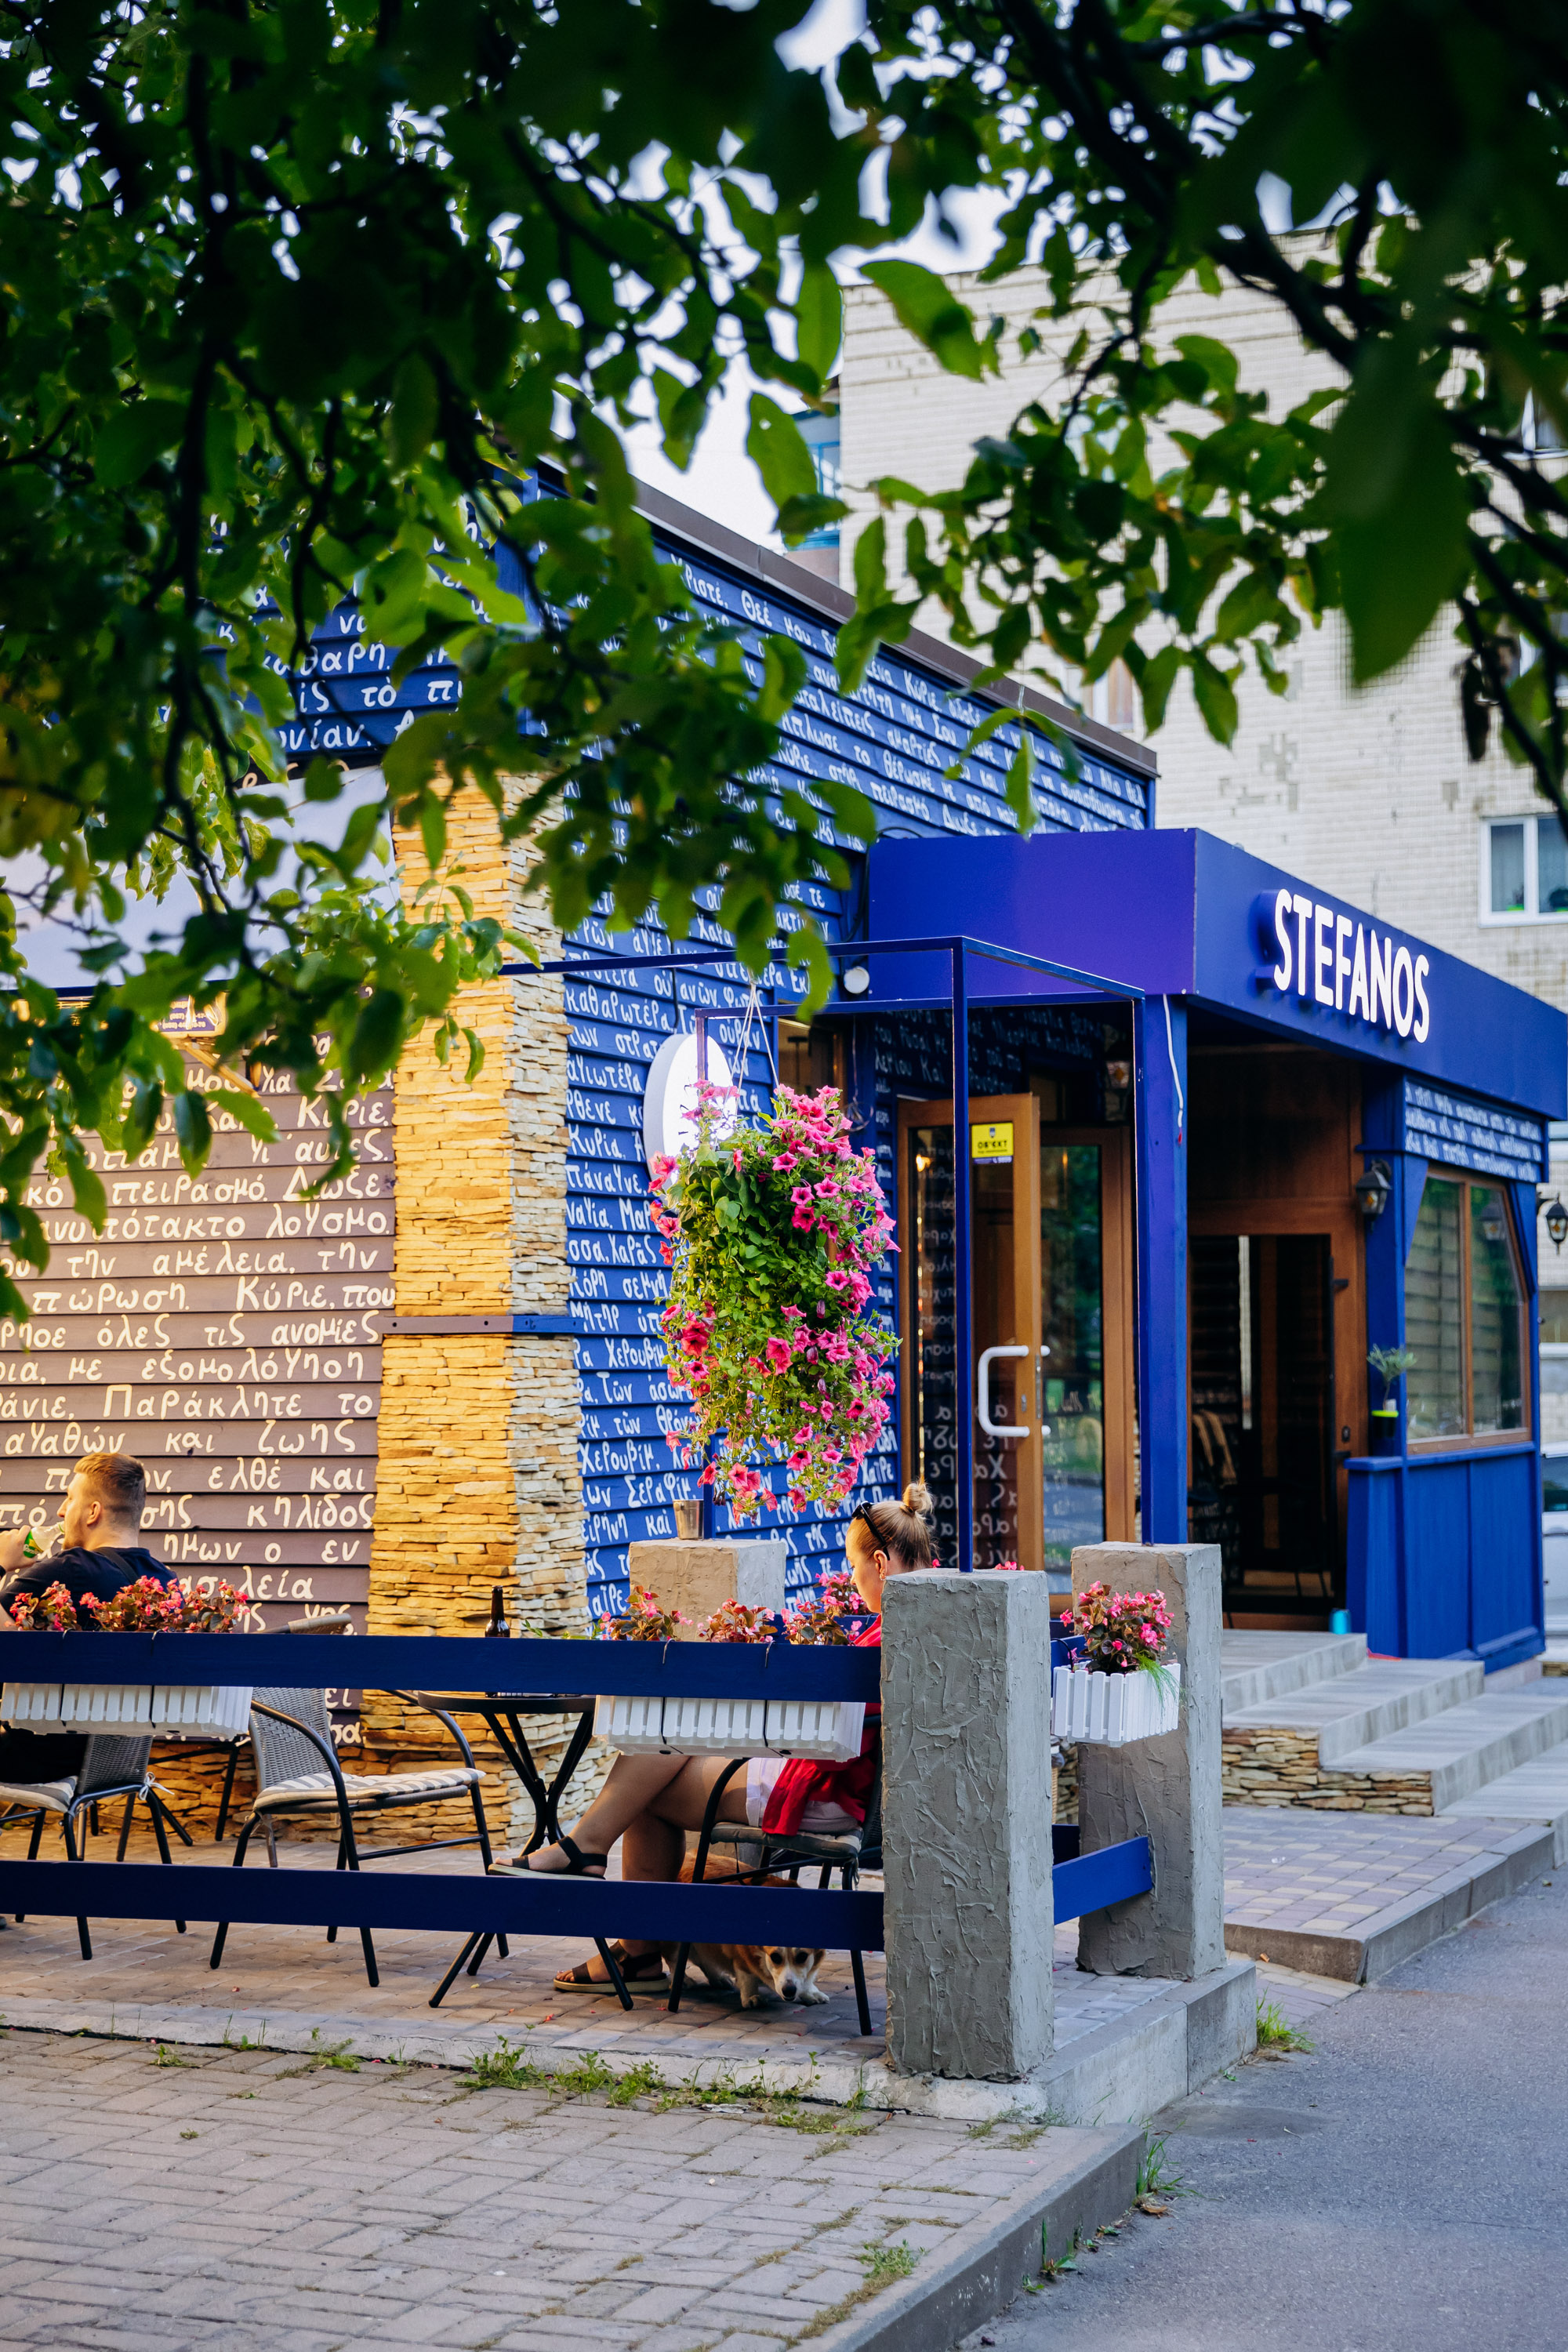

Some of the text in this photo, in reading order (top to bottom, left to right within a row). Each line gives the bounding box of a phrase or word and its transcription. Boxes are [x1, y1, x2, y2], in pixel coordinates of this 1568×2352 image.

[1273, 888, 1430, 1044] STEFANOS
[67, 1248, 117, 1279] την
[318, 1241, 379, 1271] την
[67, 1356, 103, 1381] με
[338, 1392, 374, 1414] το
[208, 1457, 366, 1491] ελθέ και
[321, 1539, 361, 1563] εν
